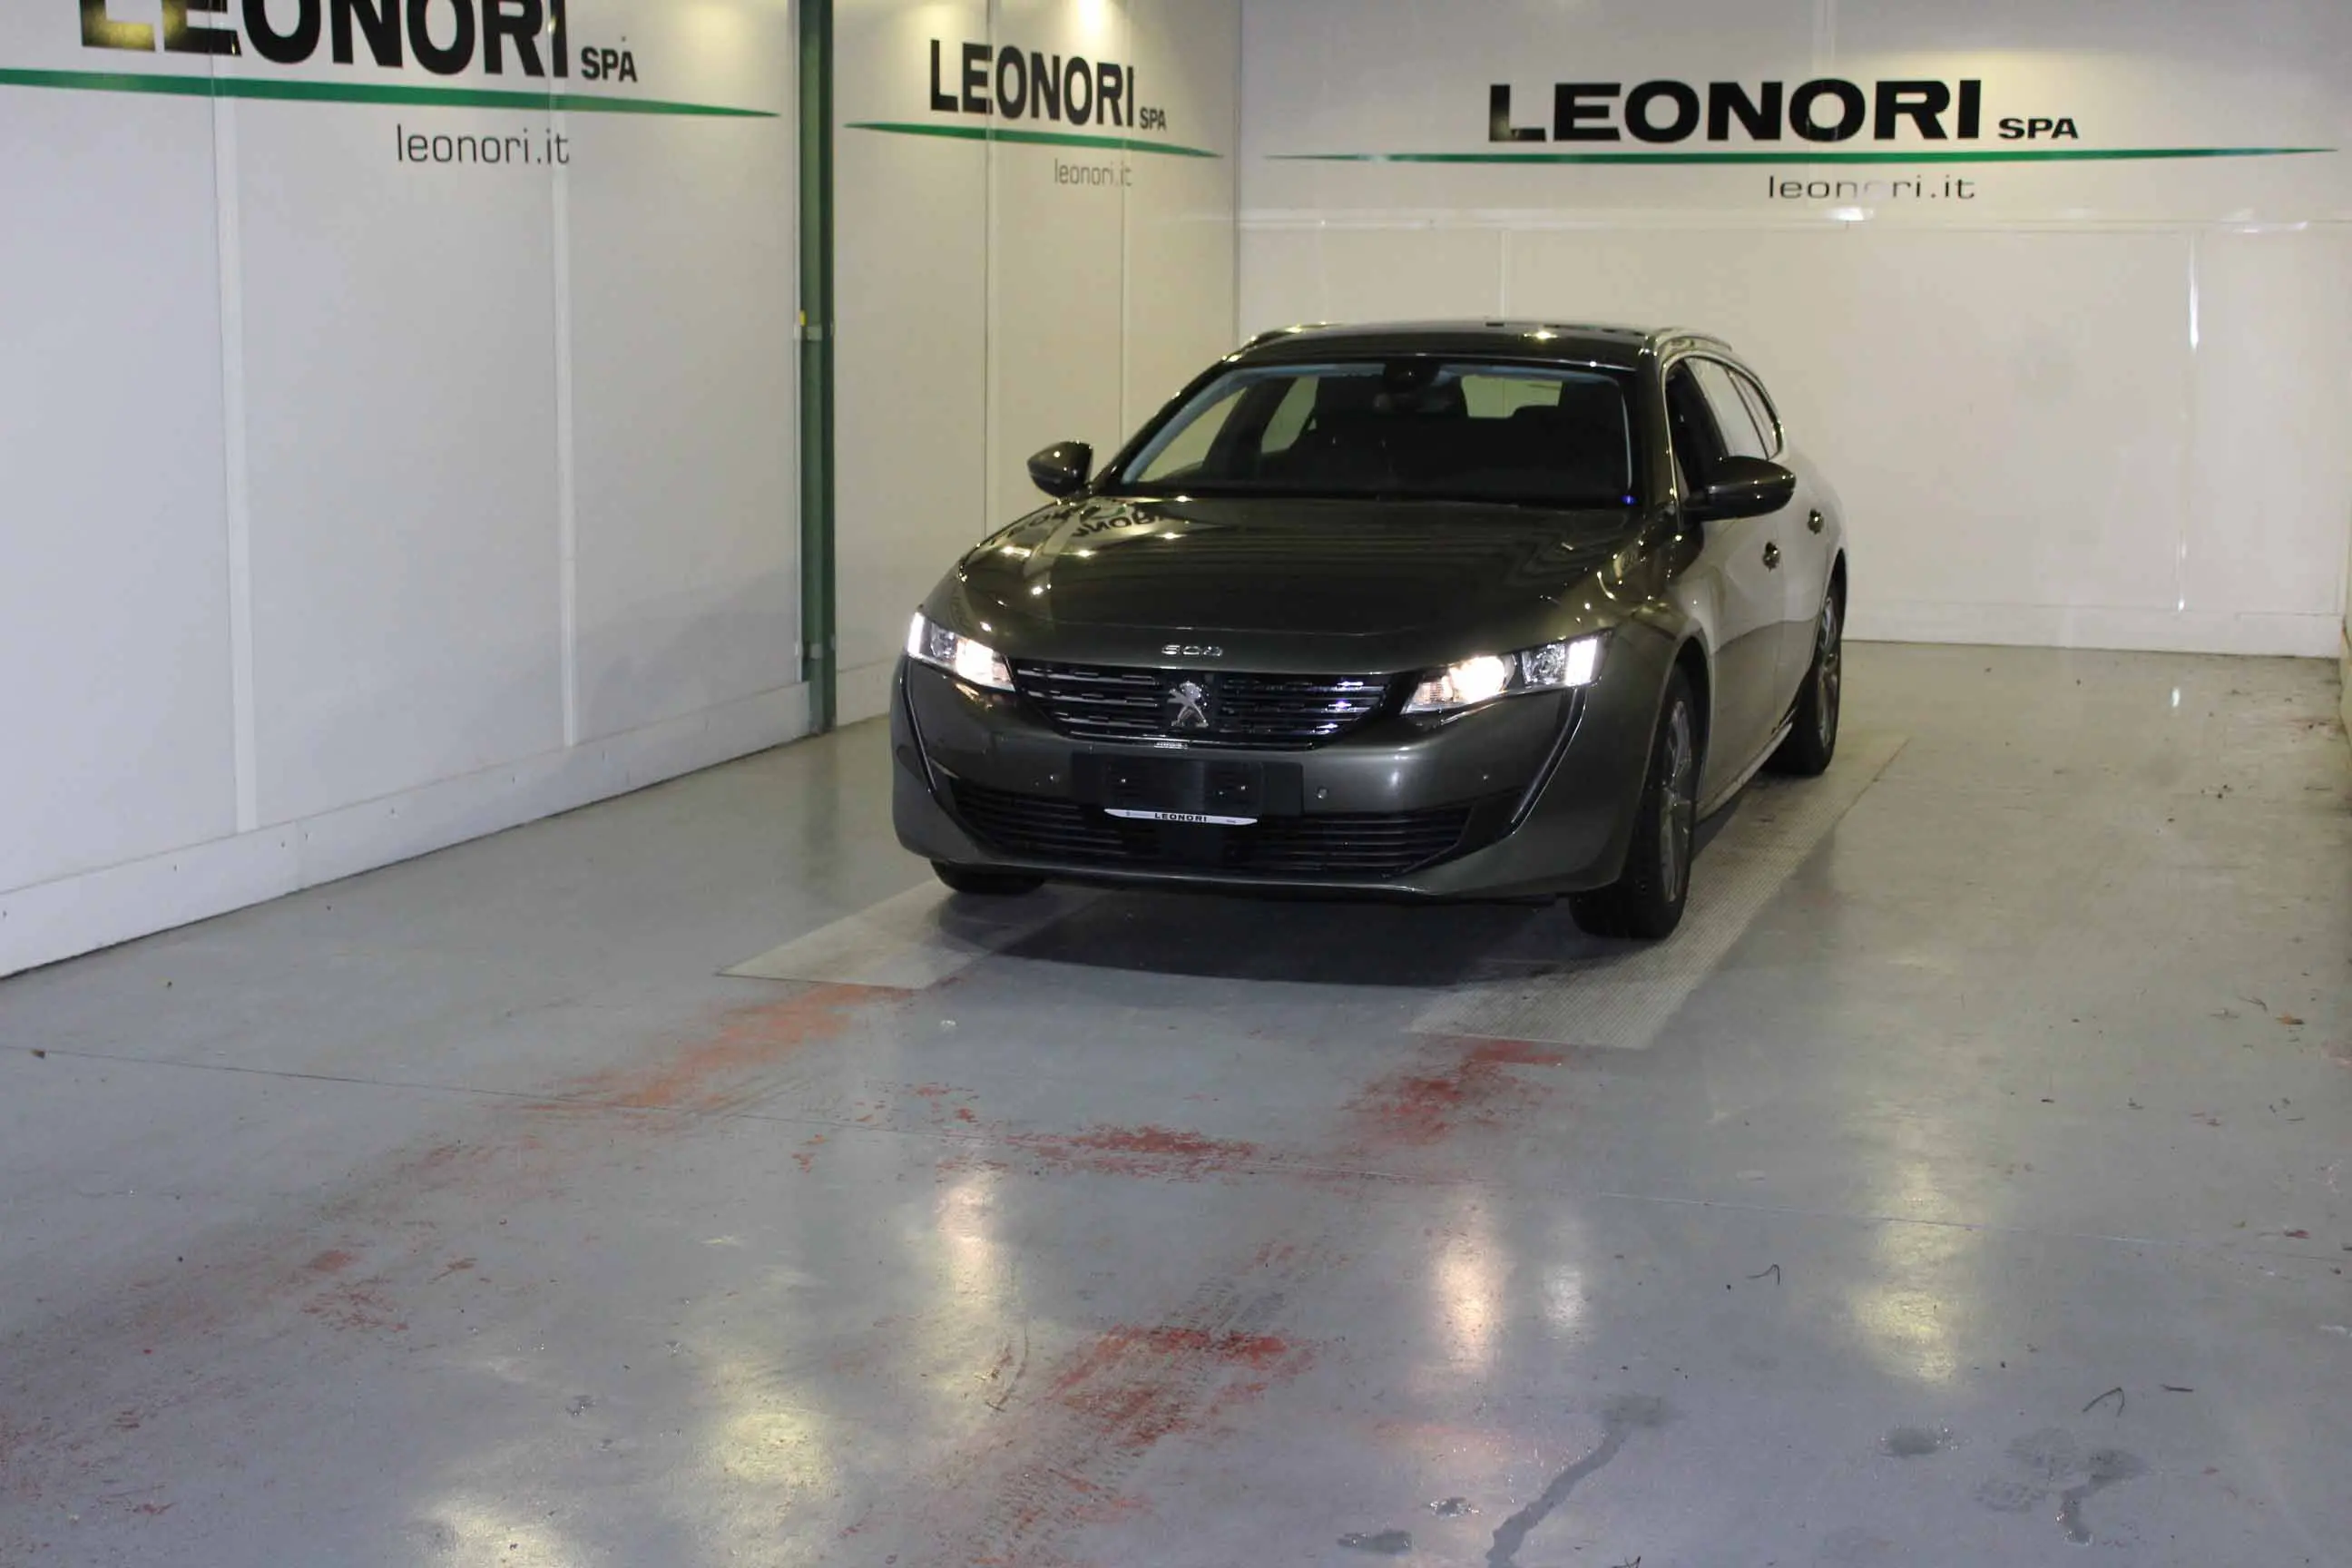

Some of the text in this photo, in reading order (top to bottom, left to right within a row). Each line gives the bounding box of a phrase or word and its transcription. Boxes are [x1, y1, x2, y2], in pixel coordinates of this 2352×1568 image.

[581, 46, 638, 83] SPA
[930, 39, 1167, 131] LEONORI SPA
[1488, 79, 2079, 143] LEONORI SPA
[397, 123, 570, 164] leonori.it
[1154, 812, 1208, 823] LEONORI
